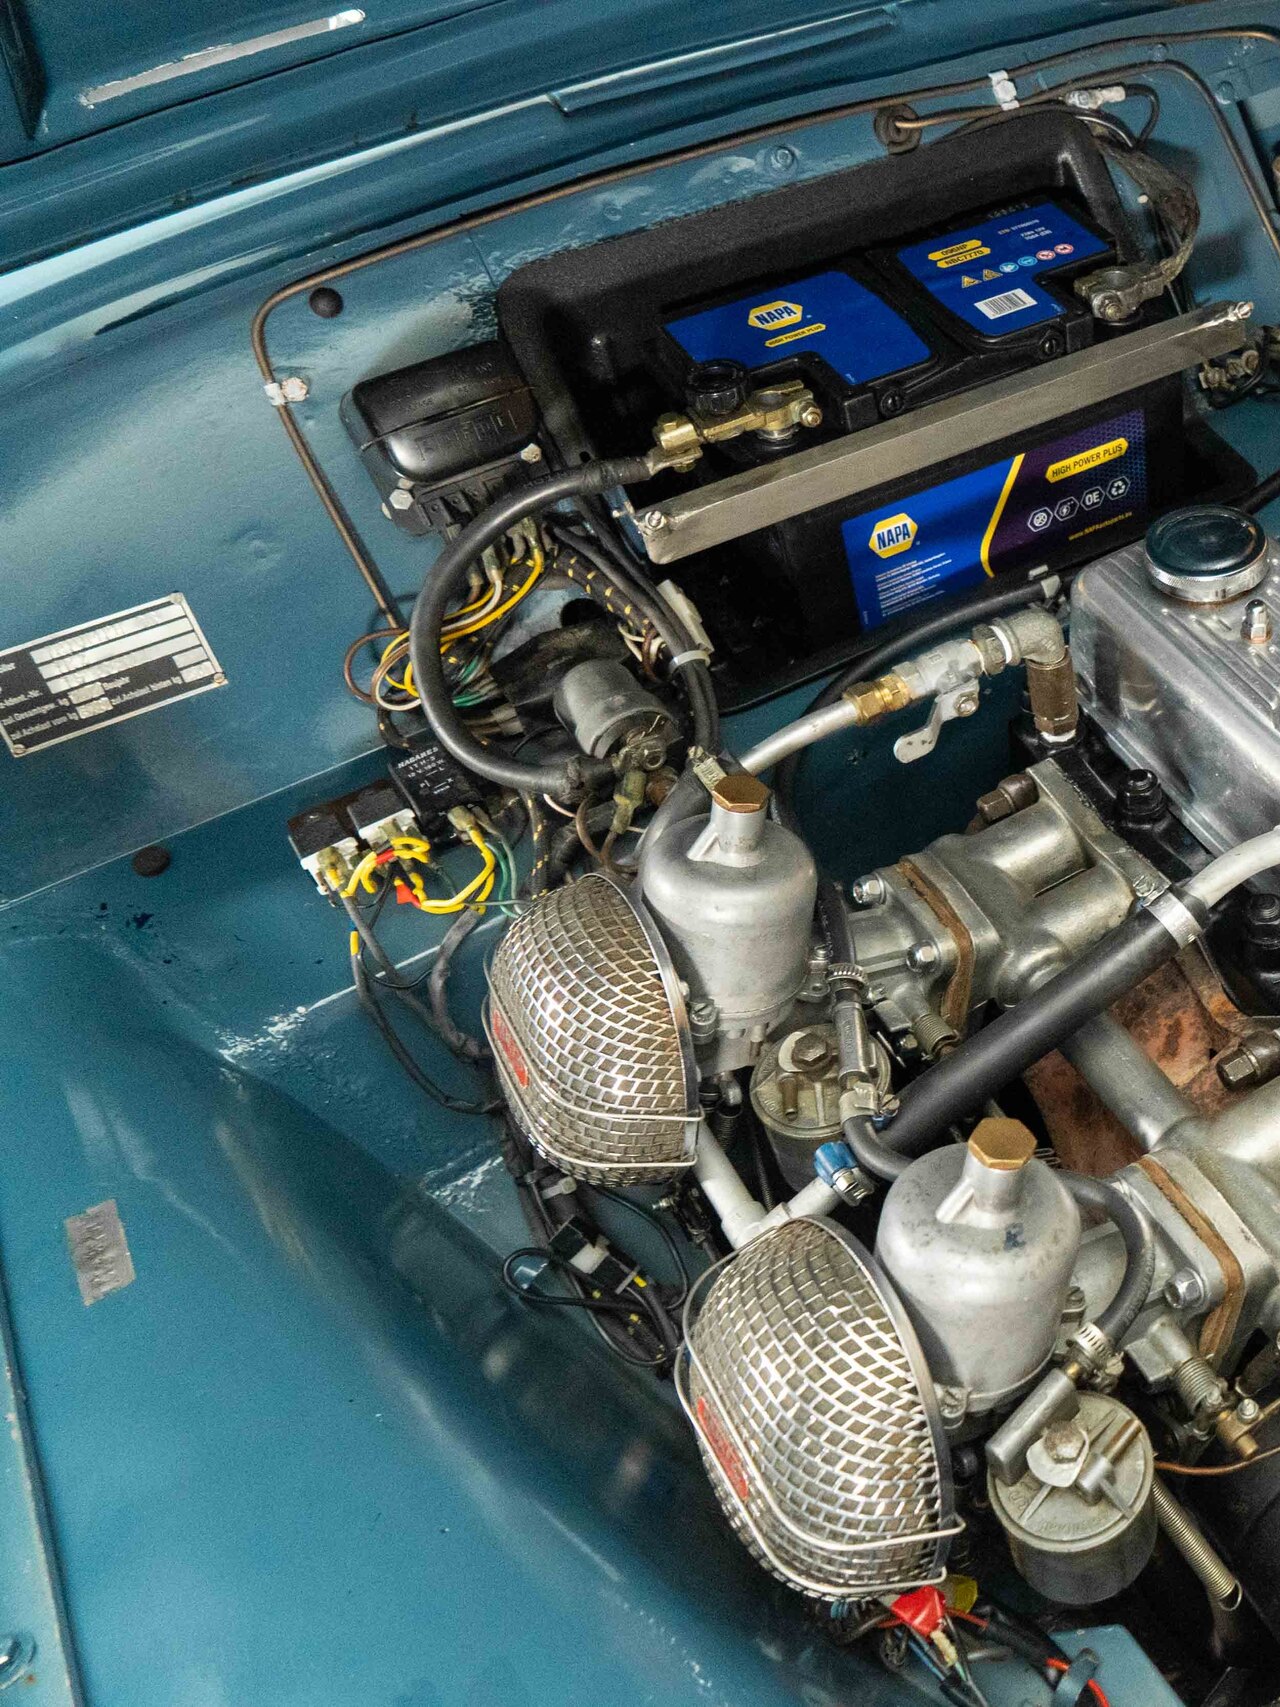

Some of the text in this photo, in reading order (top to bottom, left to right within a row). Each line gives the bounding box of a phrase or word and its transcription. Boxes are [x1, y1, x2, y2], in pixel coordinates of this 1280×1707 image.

[754, 305, 797, 326] NAPA
[784, 330, 807, 340] POWER
[1051, 443, 1123, 478] HIGH POWER PLUS
[1085, 490, 1101, 506] OE
[876, 523, 911, 550] NAPA
